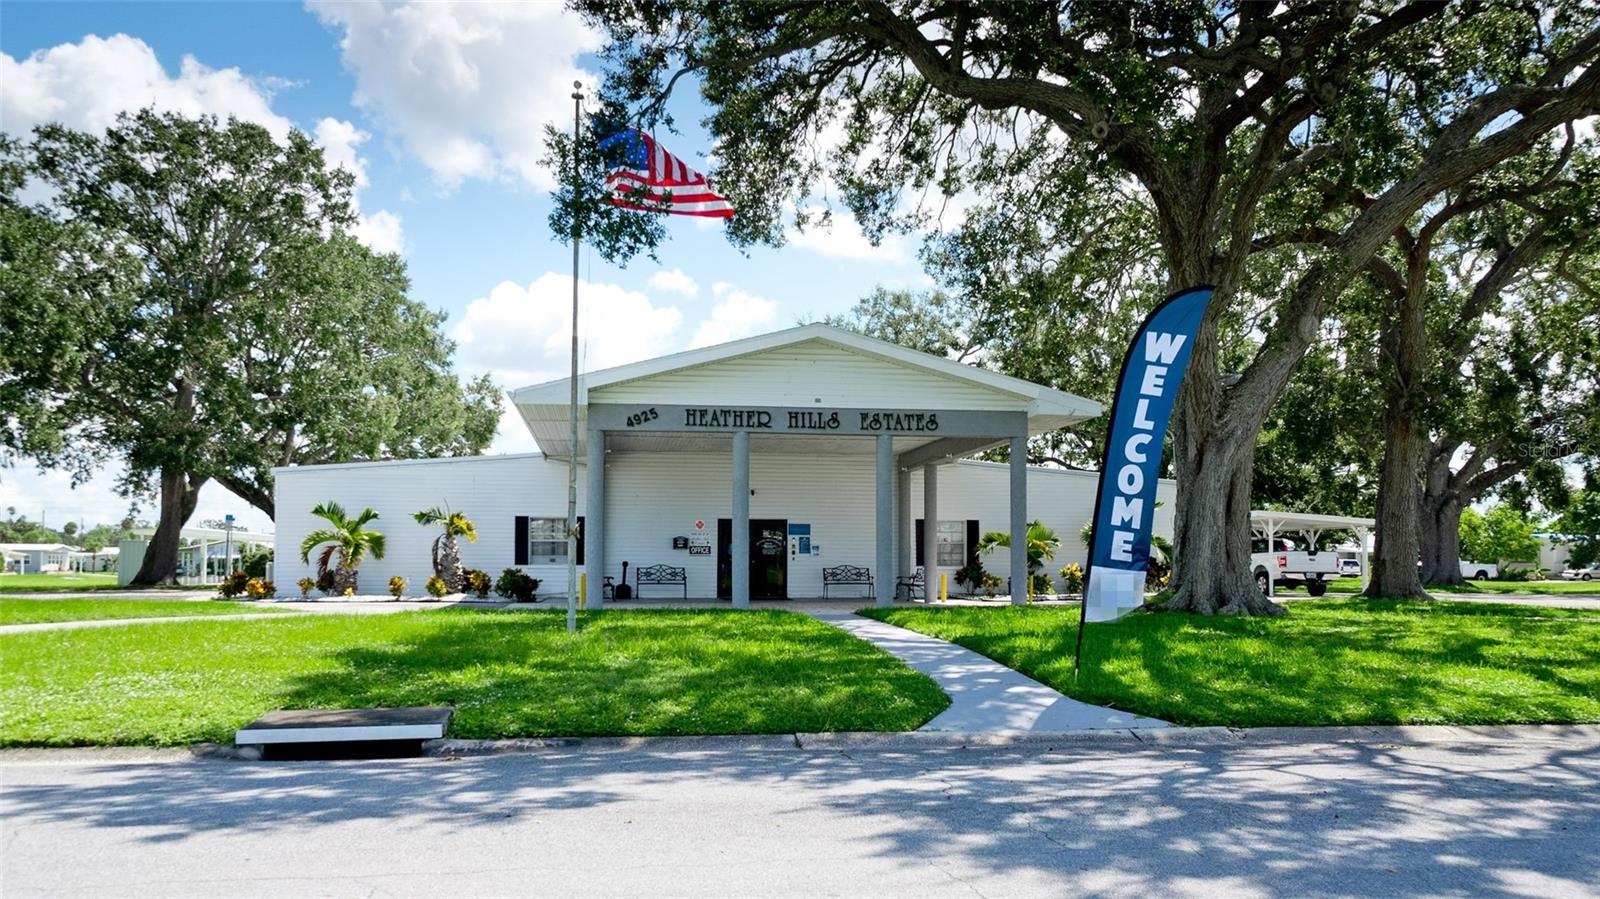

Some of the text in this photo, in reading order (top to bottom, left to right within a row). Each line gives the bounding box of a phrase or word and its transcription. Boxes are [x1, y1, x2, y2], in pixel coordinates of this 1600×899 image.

[626, 408, 658, 428] 4925
[685, 408, 938, 431] HEATHER HILLS ESTATES
[1110, 331, 1187, 562] WELCOME
[691, 546, 710, 554] OFFICE
